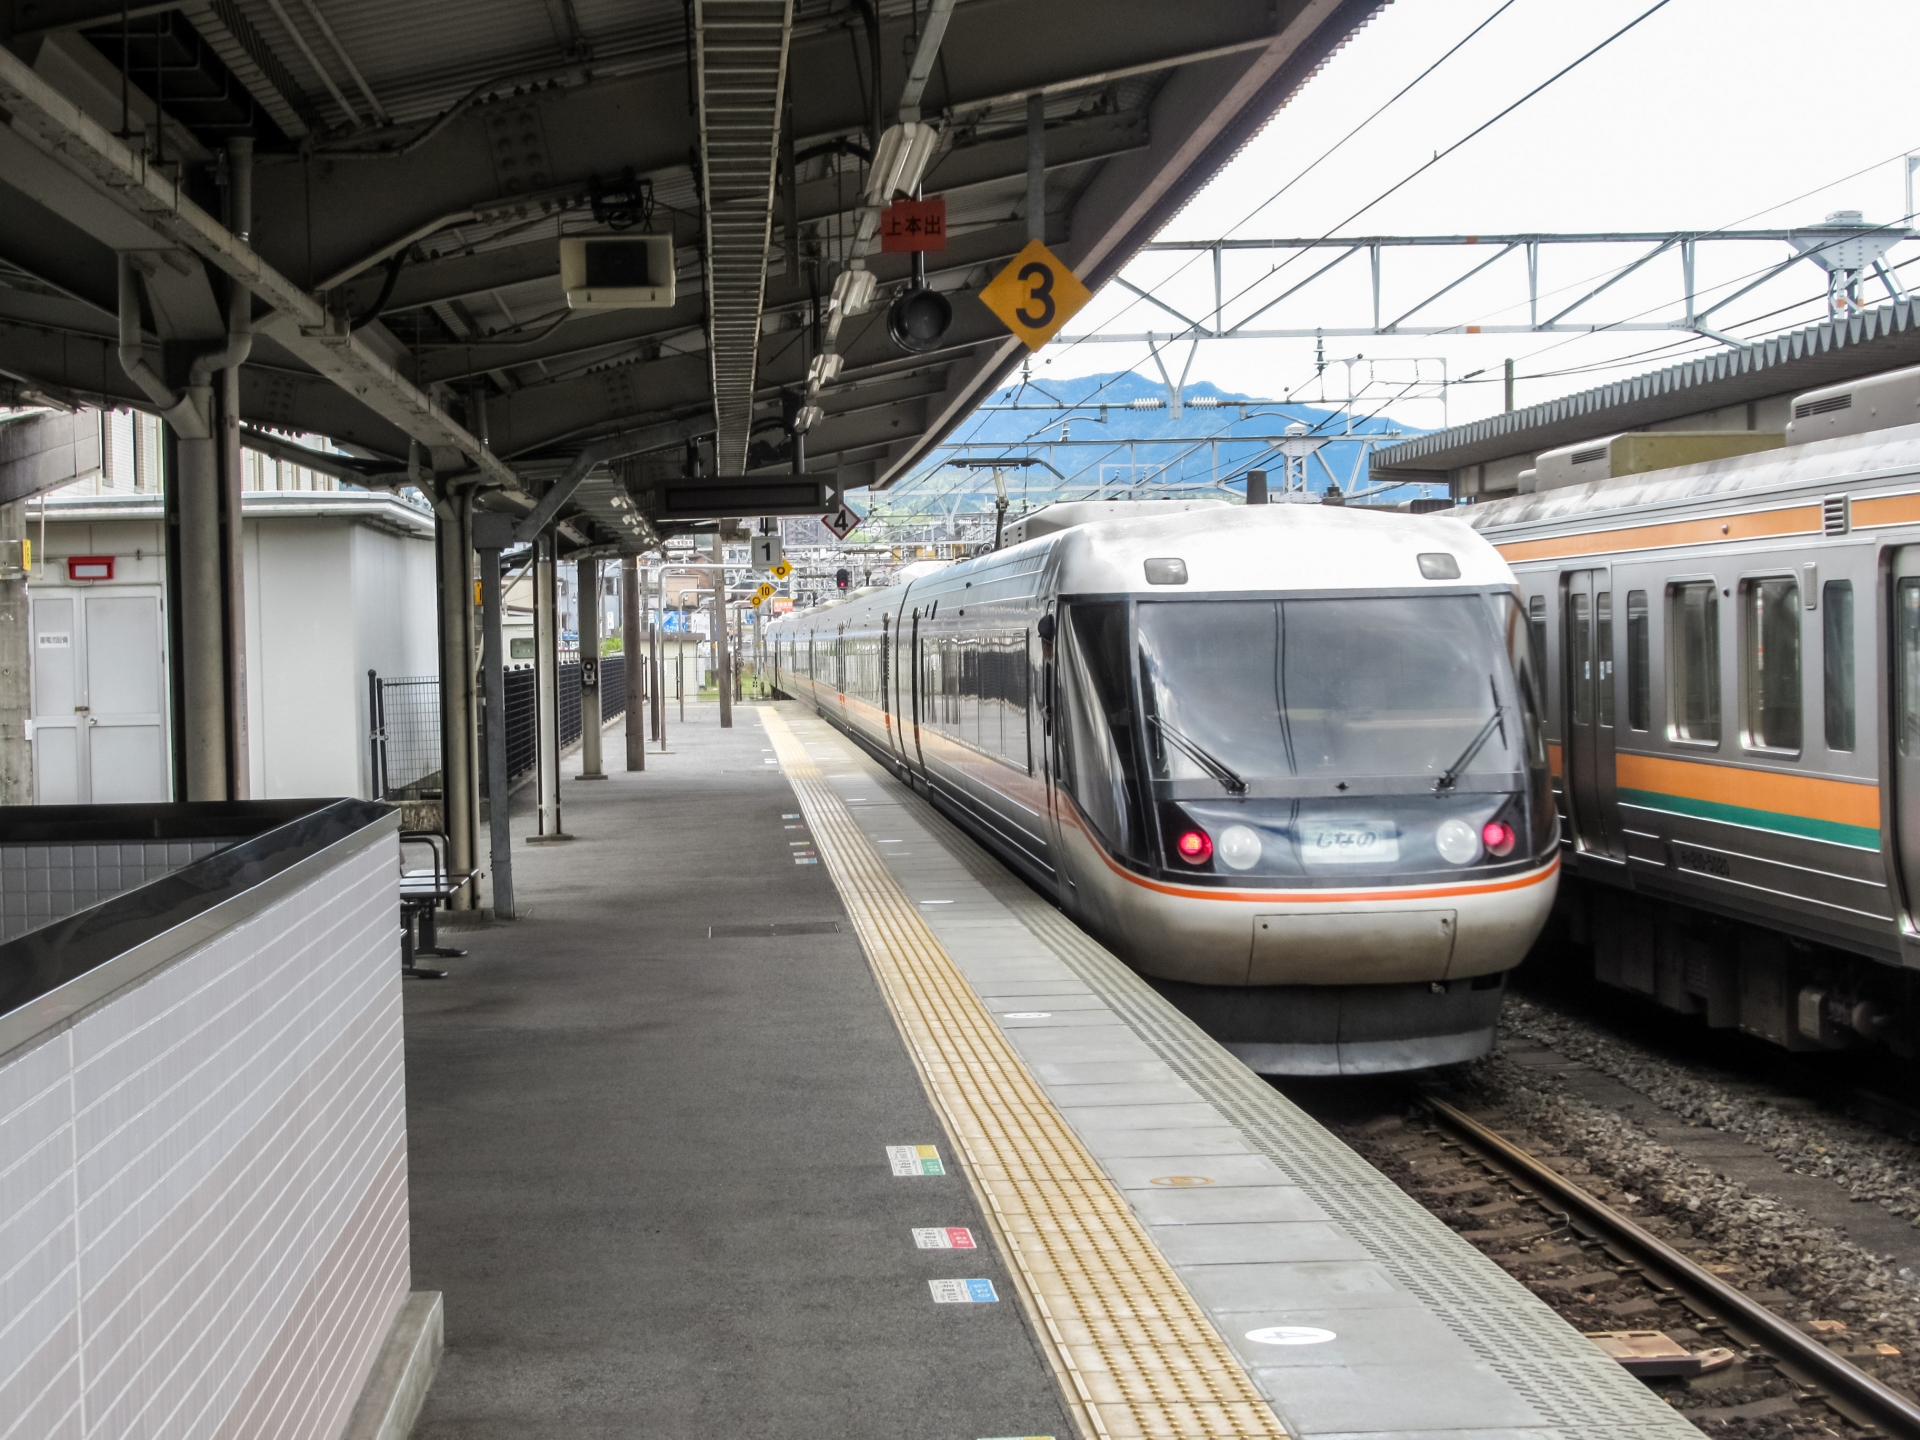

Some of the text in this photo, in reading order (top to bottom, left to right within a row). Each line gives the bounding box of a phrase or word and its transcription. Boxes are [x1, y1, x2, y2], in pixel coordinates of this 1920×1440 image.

[885, 214, 941, 237] 上本出
[1015, 261, 1056, 329] 3
[833, 509, 849, 531] 4
[761, 541, 771, 562] 1
[761, 586, 770, 597] 10
[1315, 831, 1376, 849] しなの
